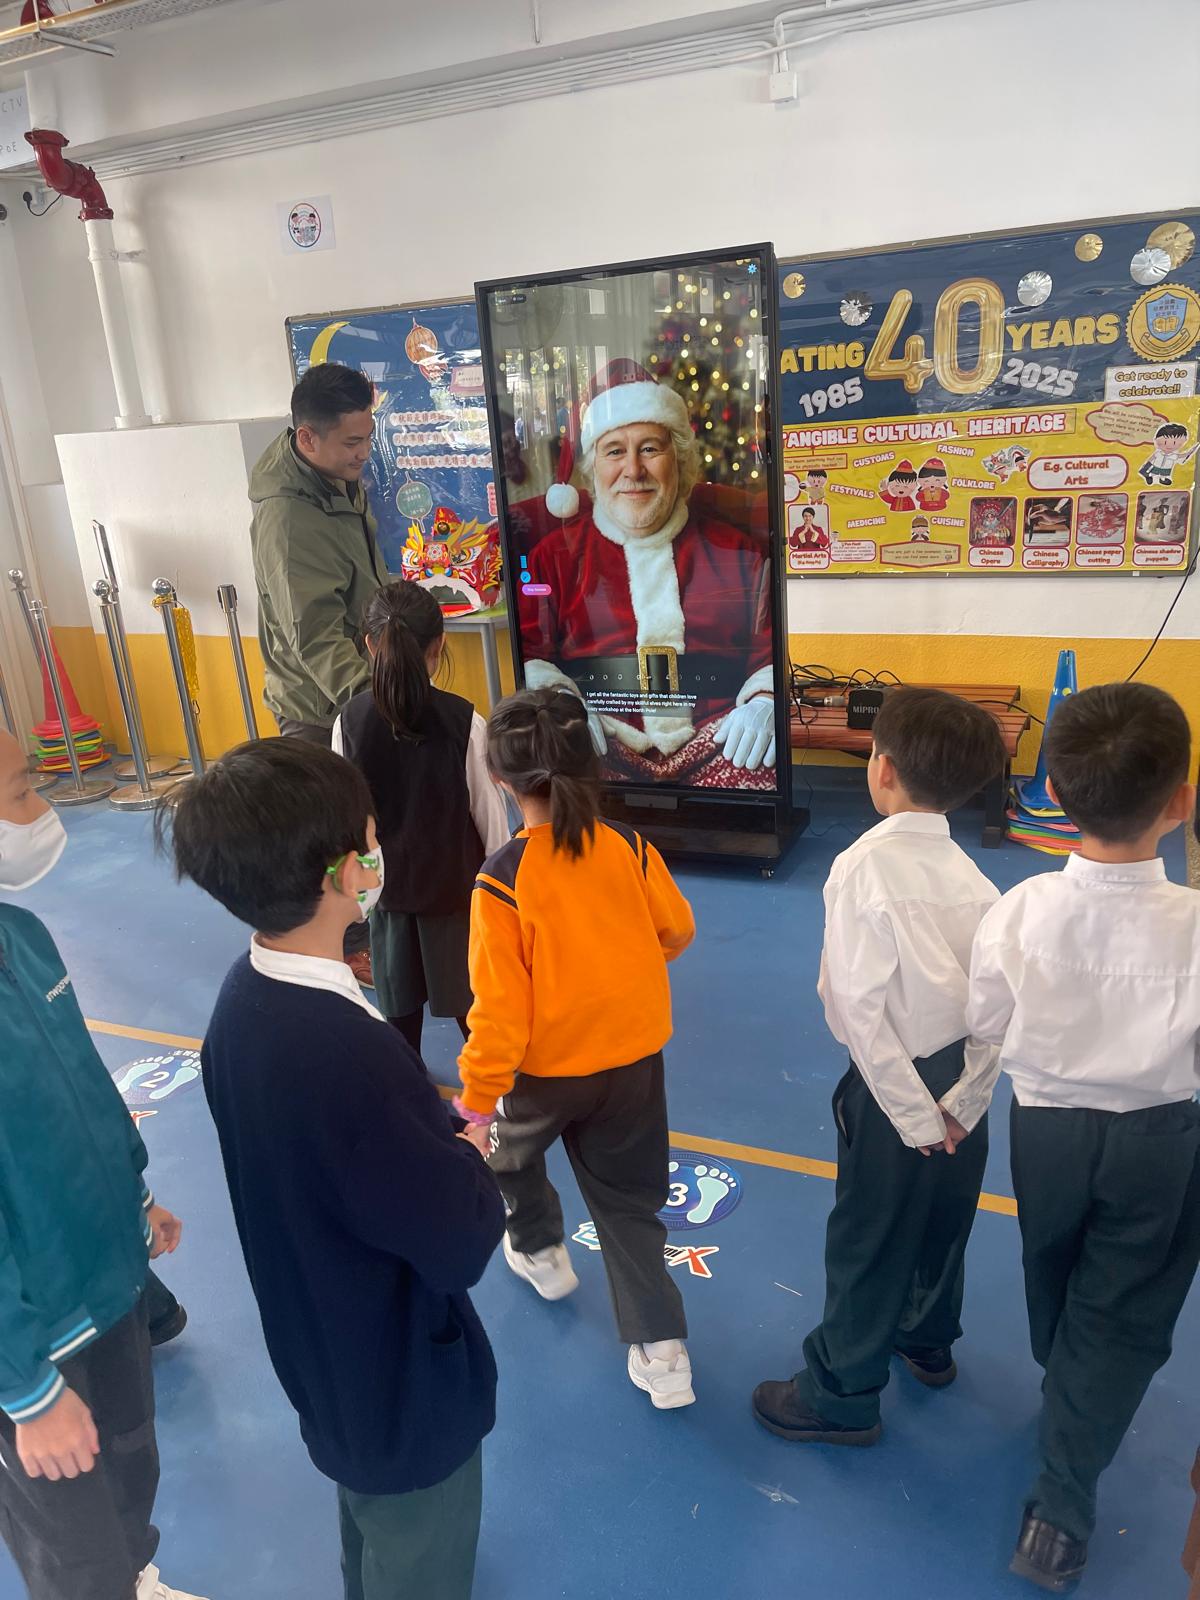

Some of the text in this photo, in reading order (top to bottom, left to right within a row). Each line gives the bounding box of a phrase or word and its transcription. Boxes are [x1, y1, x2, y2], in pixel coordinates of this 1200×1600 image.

[864, 278, 1005, 394] 40
[1006, 313, 1120, 350] YEARS
[1002, 358, 1078, 396] 2025
[1115, 368, 1187, 382] Get ready to
[798, 377, 864, 418] 1985
[1119, 384, 1181, 397] celebrate!!
[864, 420, 958, 443] CULTURAL
[968, 413, 1065, 437] HERITAGE
[937, 444, 975, 456] FASHION
[852, 452, 895, 468] CUSTOMS
[1065, 459, 1109, 470] Cultural
[951, 478, 995, 490] FOLKLORE
[1064, 475, 1089, 485] Arts
[830, 484, 875, 499] FESTIVALS
[847, 516, 887, 528] MEDICINE
[930, 517, 965, 527] CUISINE
[138, 1072, 170, 1088] 2
[666, 1182, 688, 1206] 3
